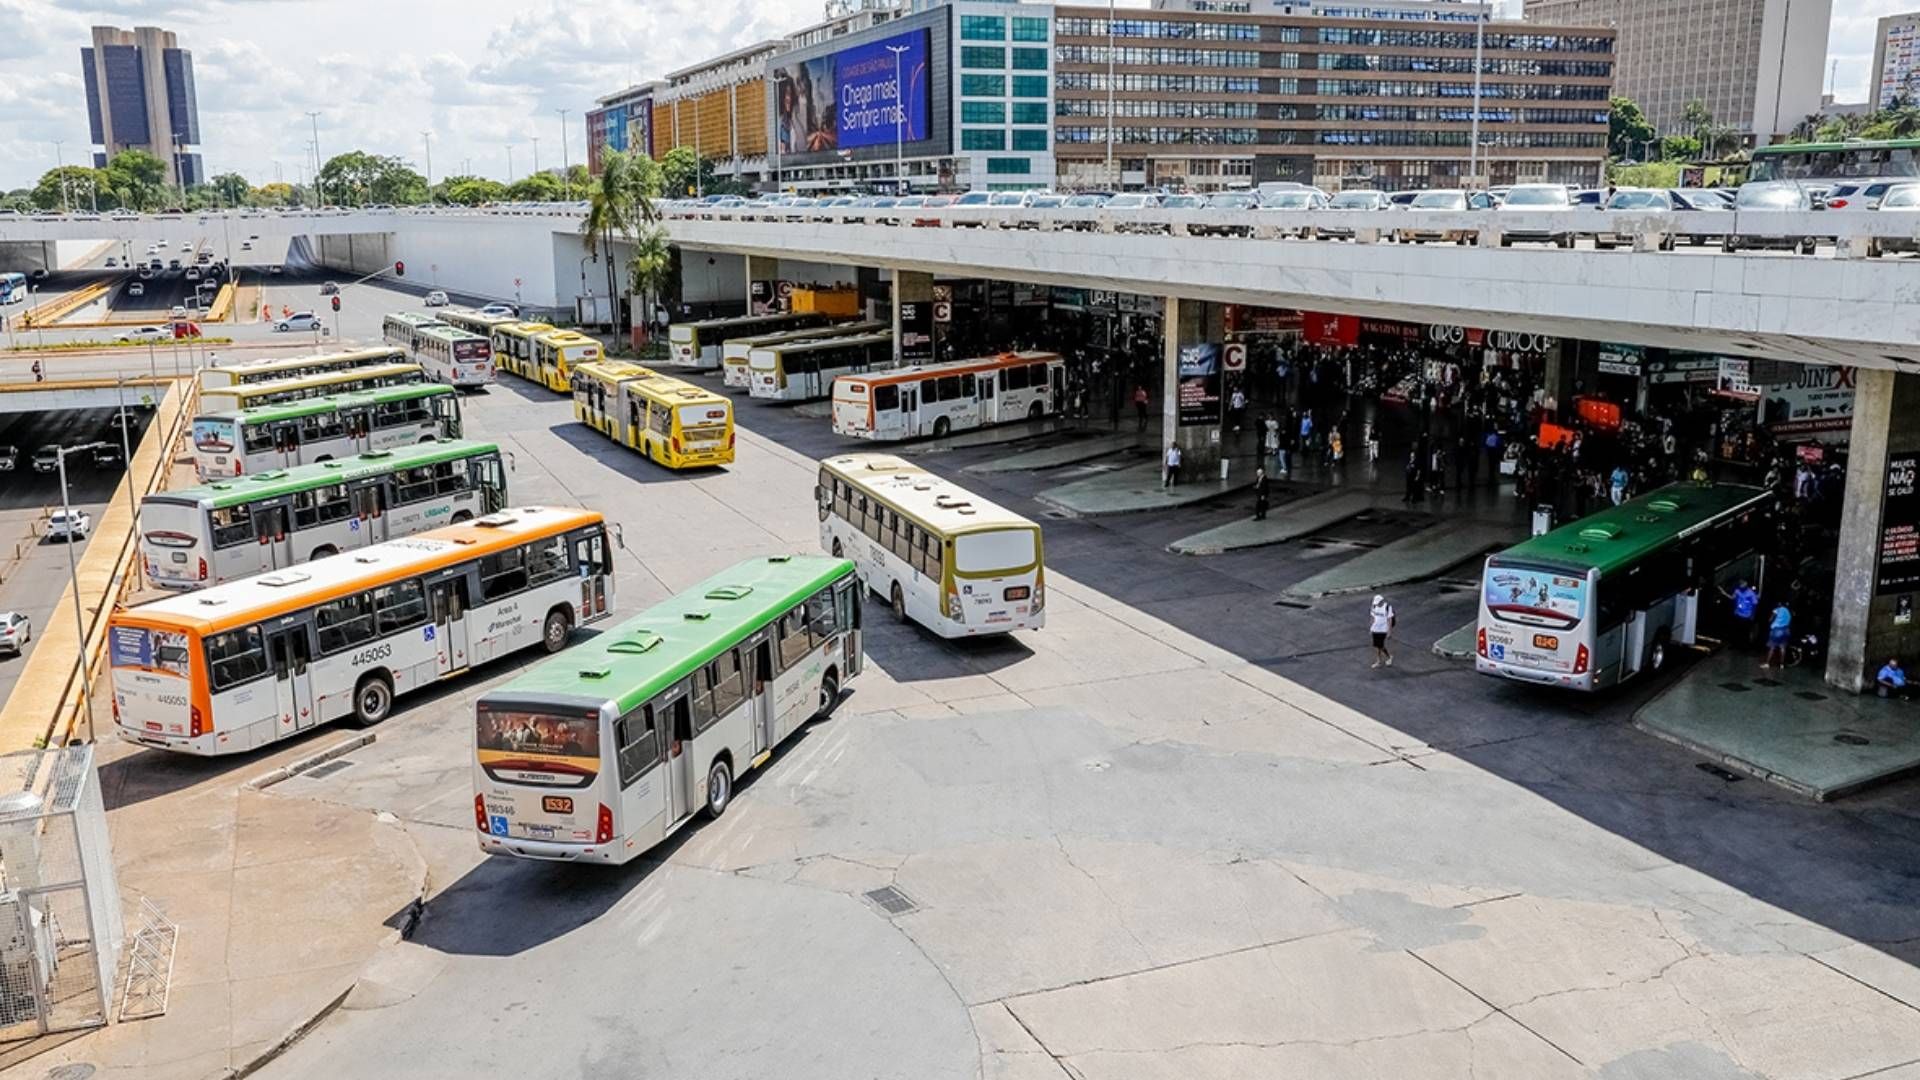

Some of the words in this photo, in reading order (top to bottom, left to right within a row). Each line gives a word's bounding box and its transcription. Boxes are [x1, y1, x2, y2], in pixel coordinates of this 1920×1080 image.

[842, 83, 872, 110] Chega
[843, 108, 880, 134] Sempre
[935, 303, 948, 319] C
[1225, 346, 1243, 367] C
[351, 643, 392, 667] 445053
[158, 695, 187, 706] 445053
